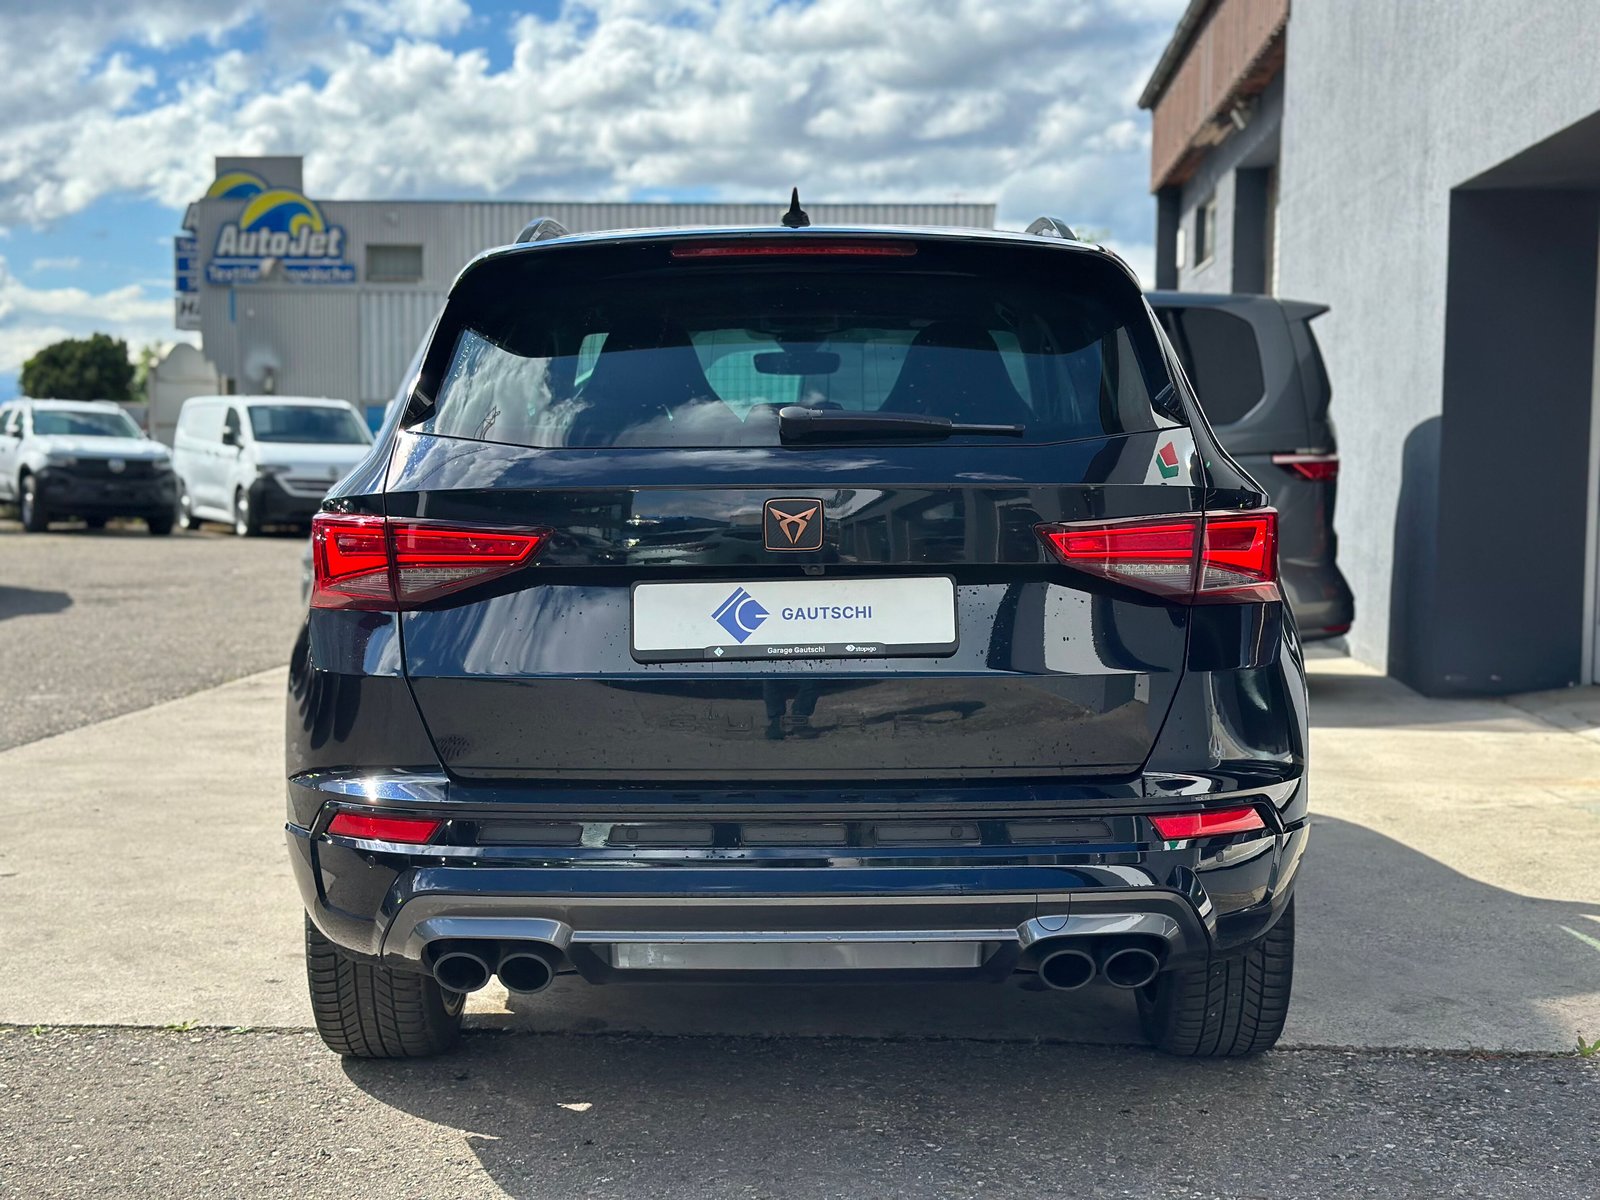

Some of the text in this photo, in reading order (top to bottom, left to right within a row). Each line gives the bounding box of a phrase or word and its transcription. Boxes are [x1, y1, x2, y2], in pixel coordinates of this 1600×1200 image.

[216, 224, 342, 256] AutoJet
[781, 605, 872, 620] GAUTSCHI
[767, 647, 793, 655] Garage
[794, 645, 826, 654] Gautschi
